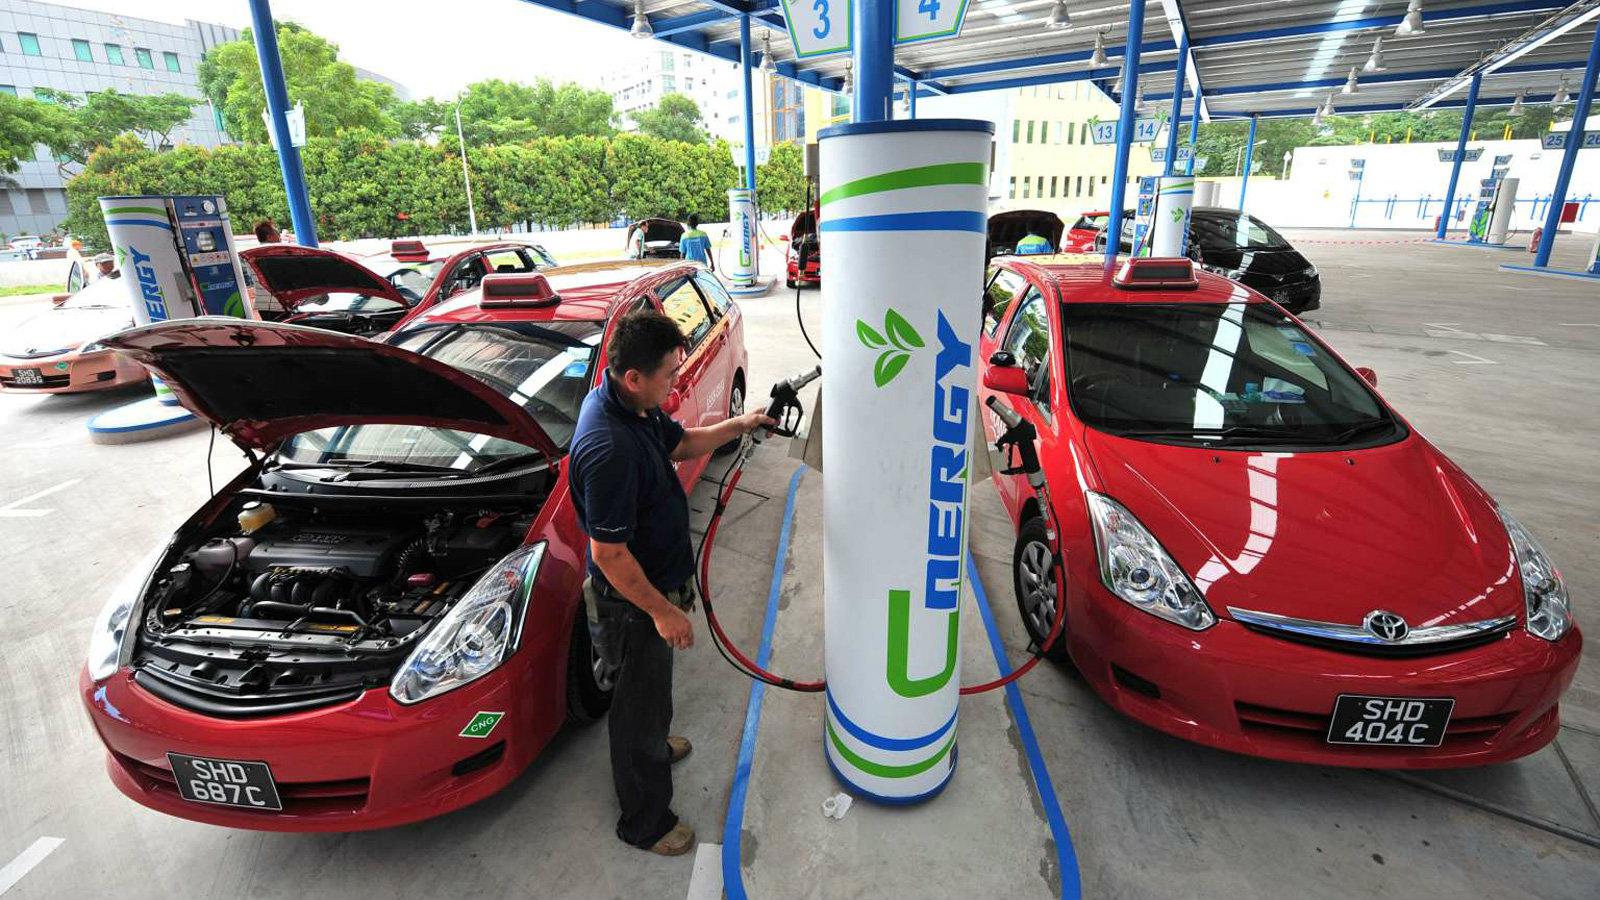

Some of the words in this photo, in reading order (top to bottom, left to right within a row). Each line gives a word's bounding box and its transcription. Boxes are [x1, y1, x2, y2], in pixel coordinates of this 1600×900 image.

[812, 0, 831, 40] 3
[918, 0, 940, 21] 4
[1097, 125, 1113, 139] 13
[1137, 122, 1154, 137] 14
[1586, 133, 1600, 146] 26
[1546, 134, 1563, 147] 25
[1178, 149, 1190, 159] 24
[130, 246, 168, 322] ERGY
[1363, 699, 1425, 722] SHD
[471, 716, 495, 732] CNG
[1345, 721, 1429, 744] 404C
[191, 759, 248, 784] SHD
[190, 779, 266, 806] 687C
